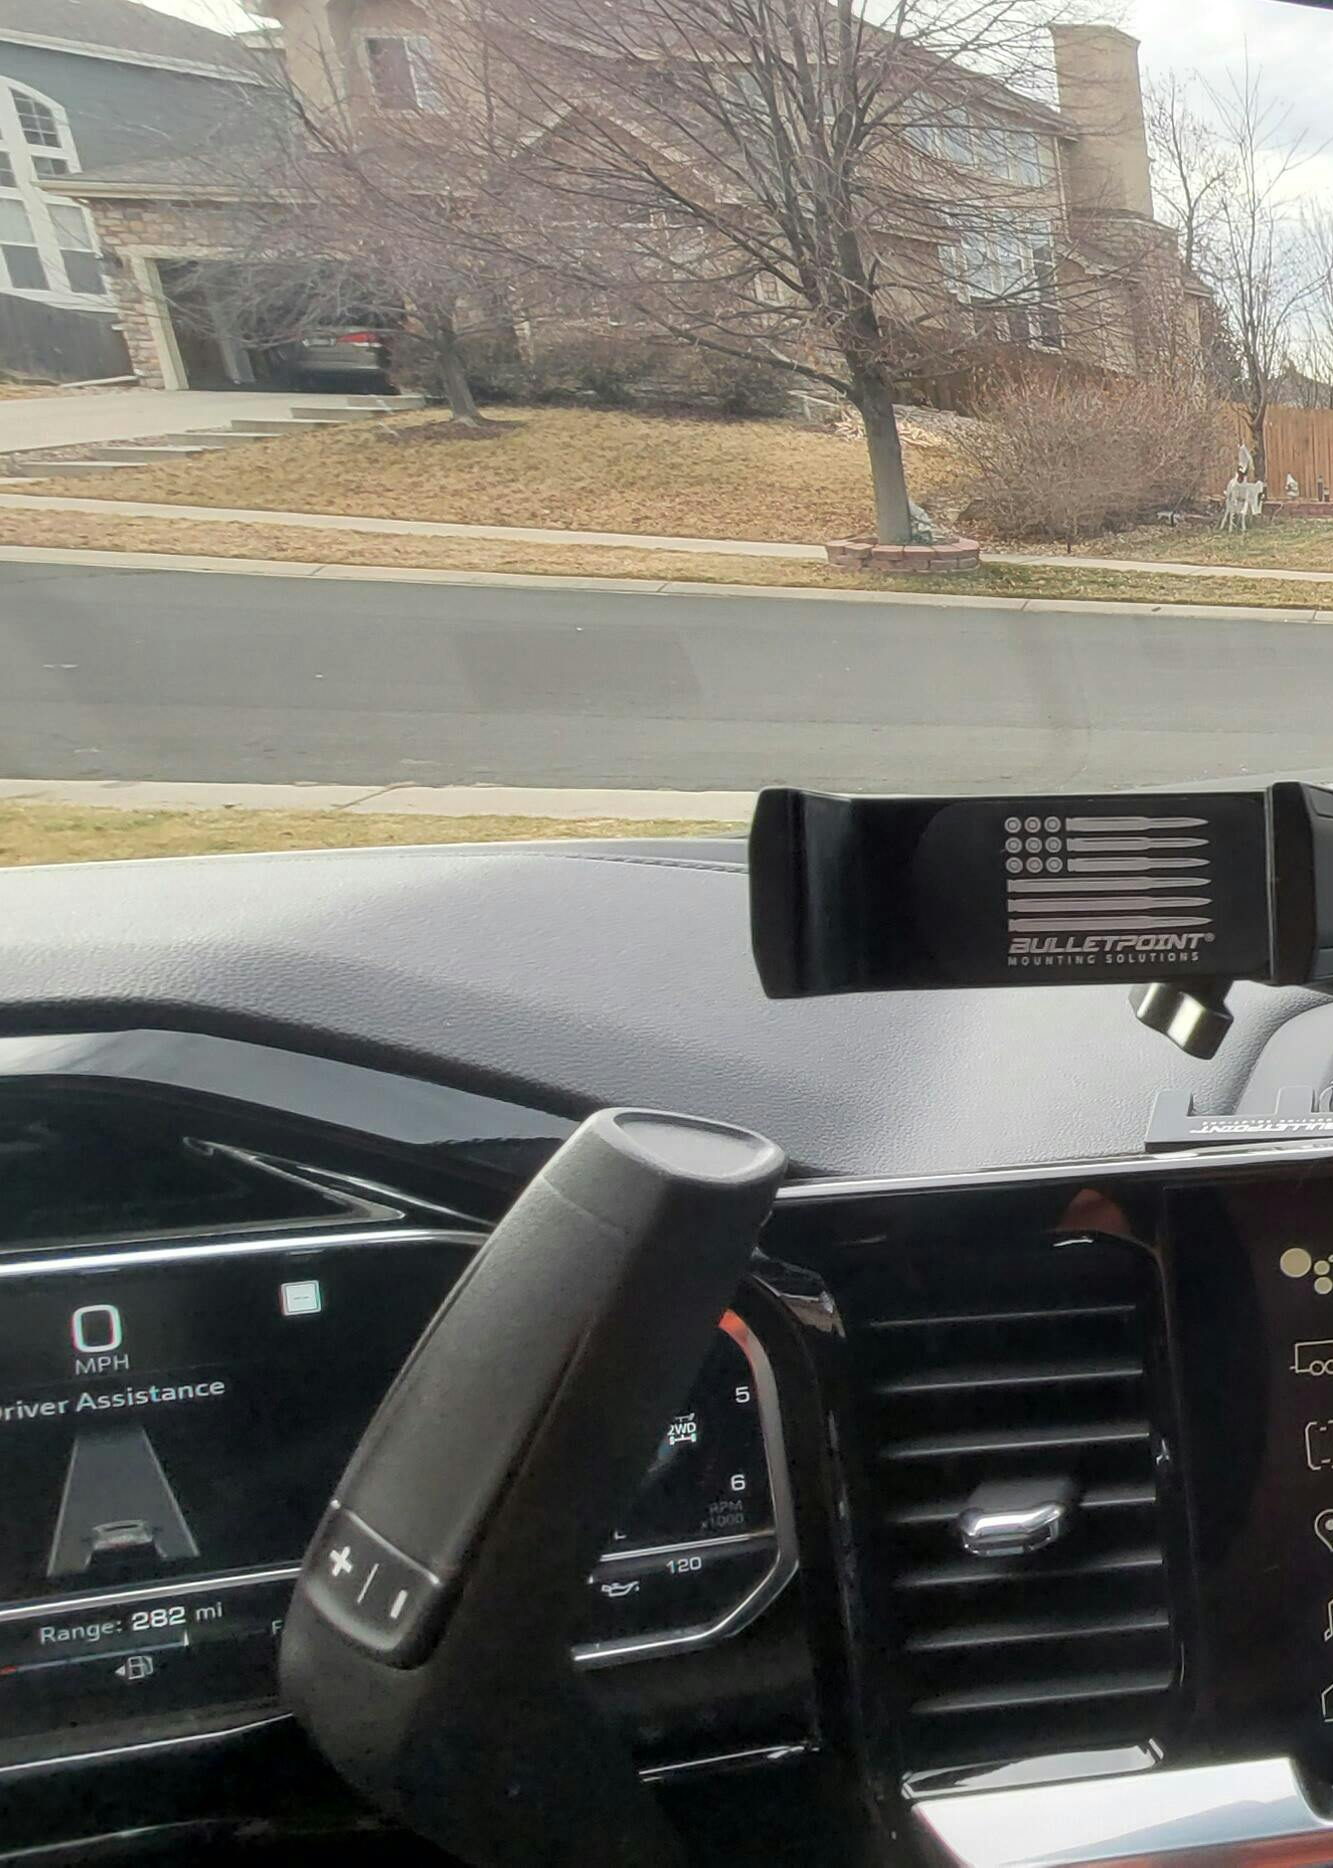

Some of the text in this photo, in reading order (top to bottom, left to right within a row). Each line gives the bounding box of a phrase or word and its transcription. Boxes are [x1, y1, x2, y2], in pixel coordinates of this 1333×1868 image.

[1008, 951, 1199, 967] MOUNTING SOLUTIONS
[75, 1354, 130, 1375] MPH
[76, 1381, 225, 1412] Assistance
[735, 1386, 750, 1403] 5
[667, 1421, 697, 1436] 2WD
[731, 1474, 745, 1491] 6
[710, 1500, 743, 1514] RPM
[666, 1556, 702, 1574] 120
[40, 1602, 222, 1645] Range: 282 mi
